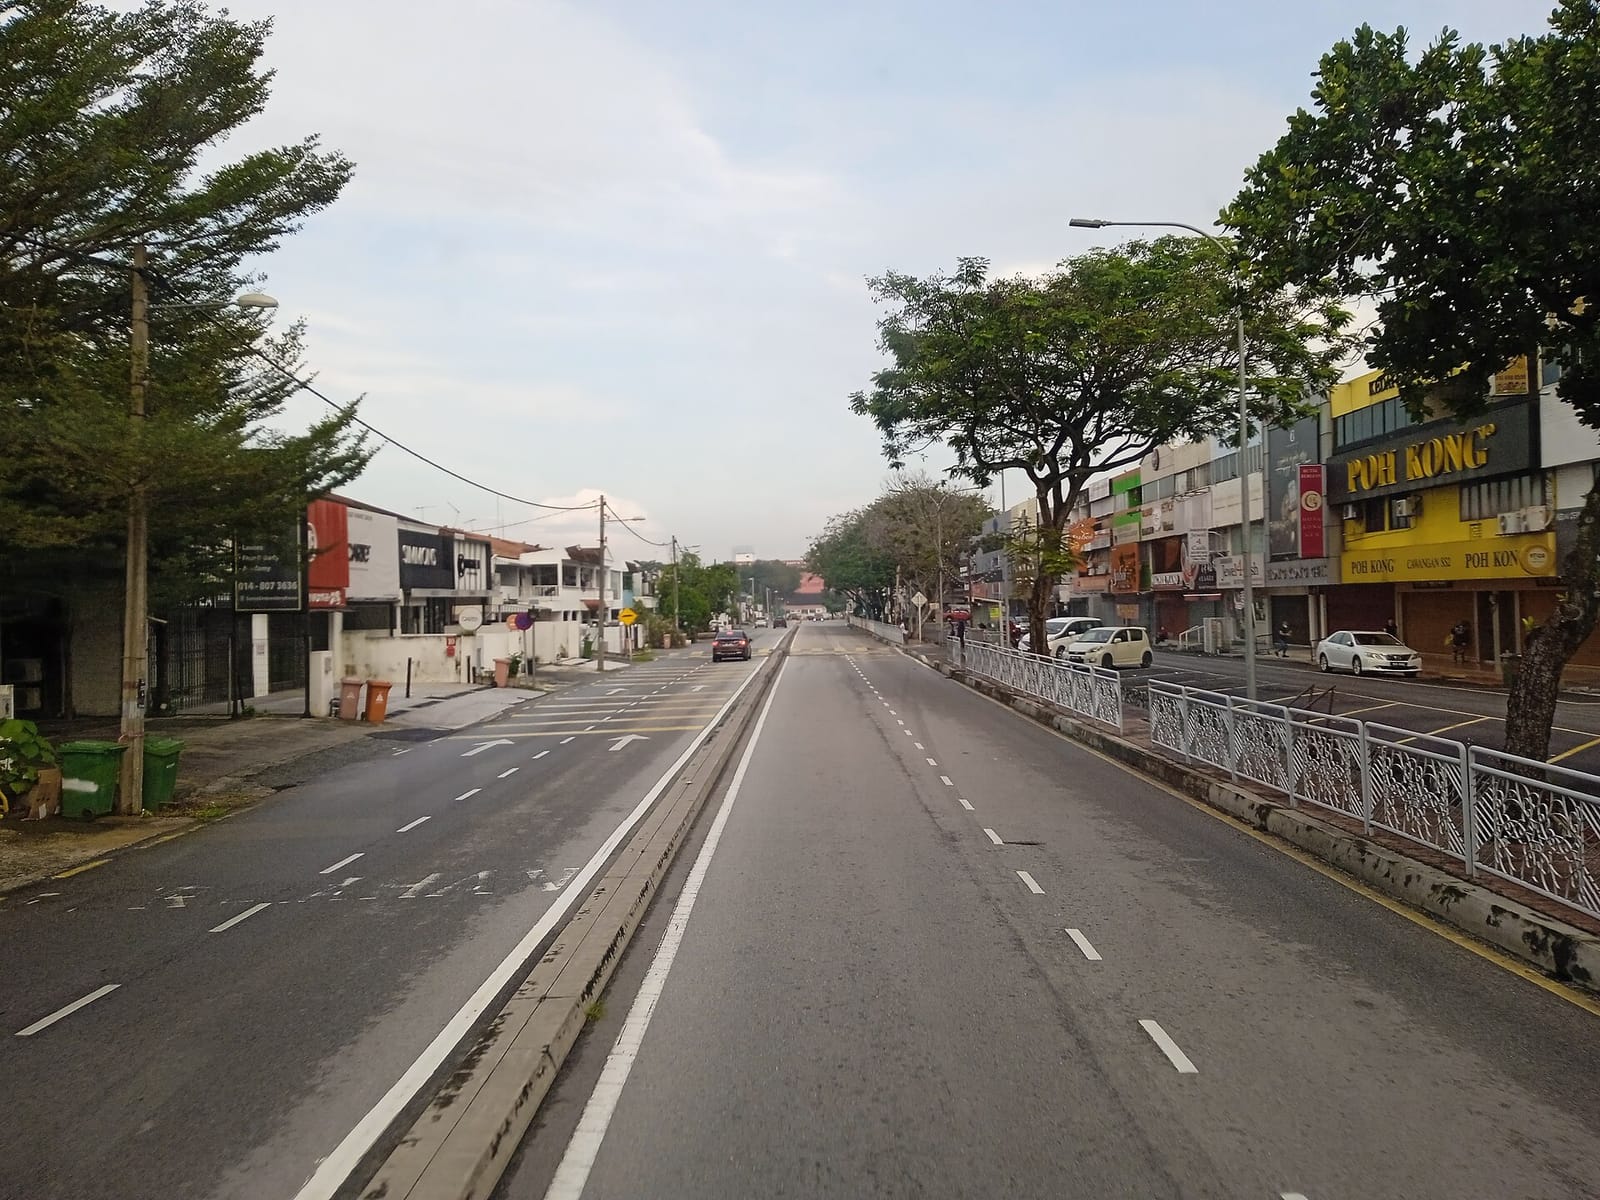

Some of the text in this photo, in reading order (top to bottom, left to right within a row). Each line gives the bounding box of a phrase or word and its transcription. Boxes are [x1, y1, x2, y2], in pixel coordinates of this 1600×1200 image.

[1347, 449, 1397, 493] POH
[1406, 427, 1491, 481] KONG
[1351, 559, 1393, 574] POH KONG
[1465, 550, 1518, 568] POH KON
